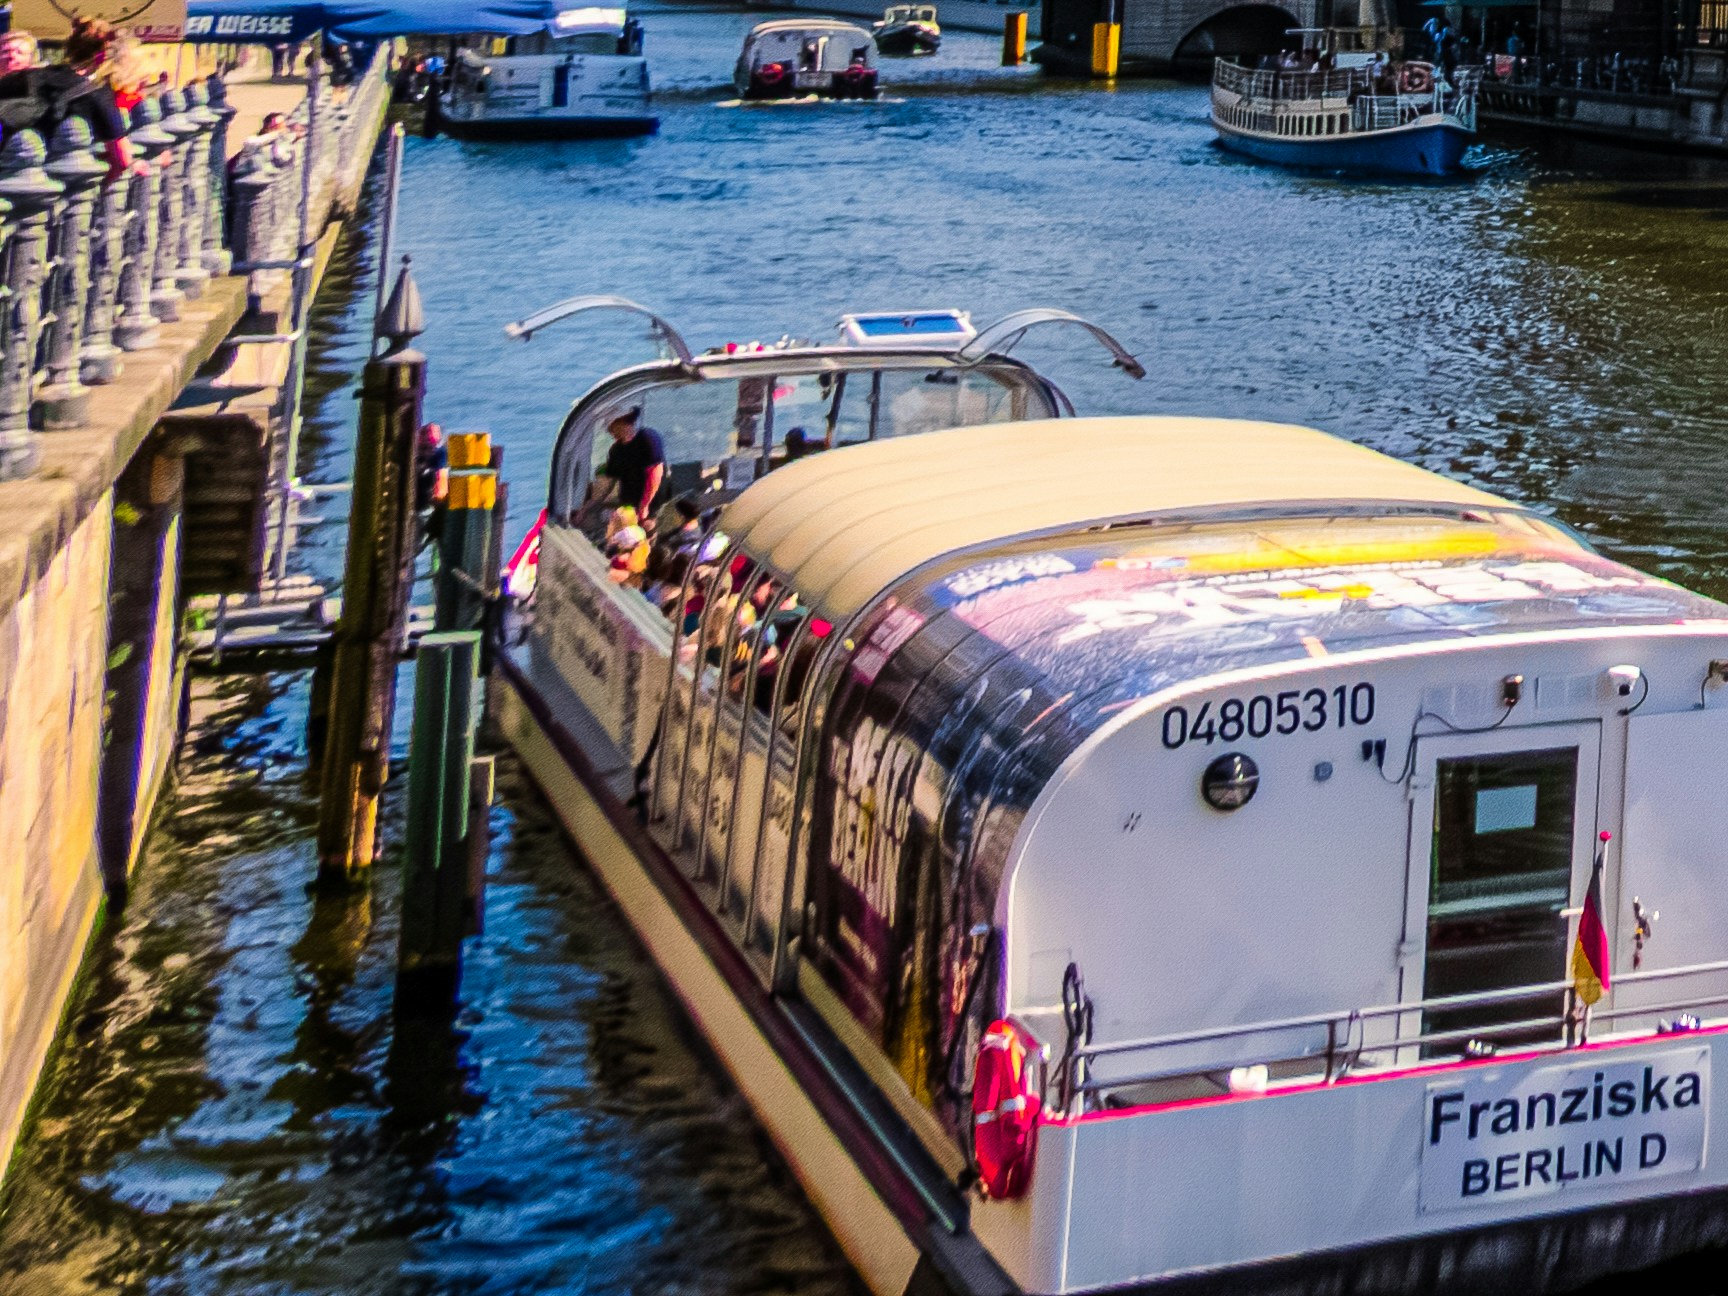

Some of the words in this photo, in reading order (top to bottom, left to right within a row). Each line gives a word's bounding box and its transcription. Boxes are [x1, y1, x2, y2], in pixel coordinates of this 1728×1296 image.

[217, 15, 294, 35] WEISSE
[1161, 681, 1376, 750] 04805310
[1429, 1065, 1701, 1146] Franziska
[1461, 1136, 1624, 1198] BERLIN
[1638, 1132, 1668, 1170] D
